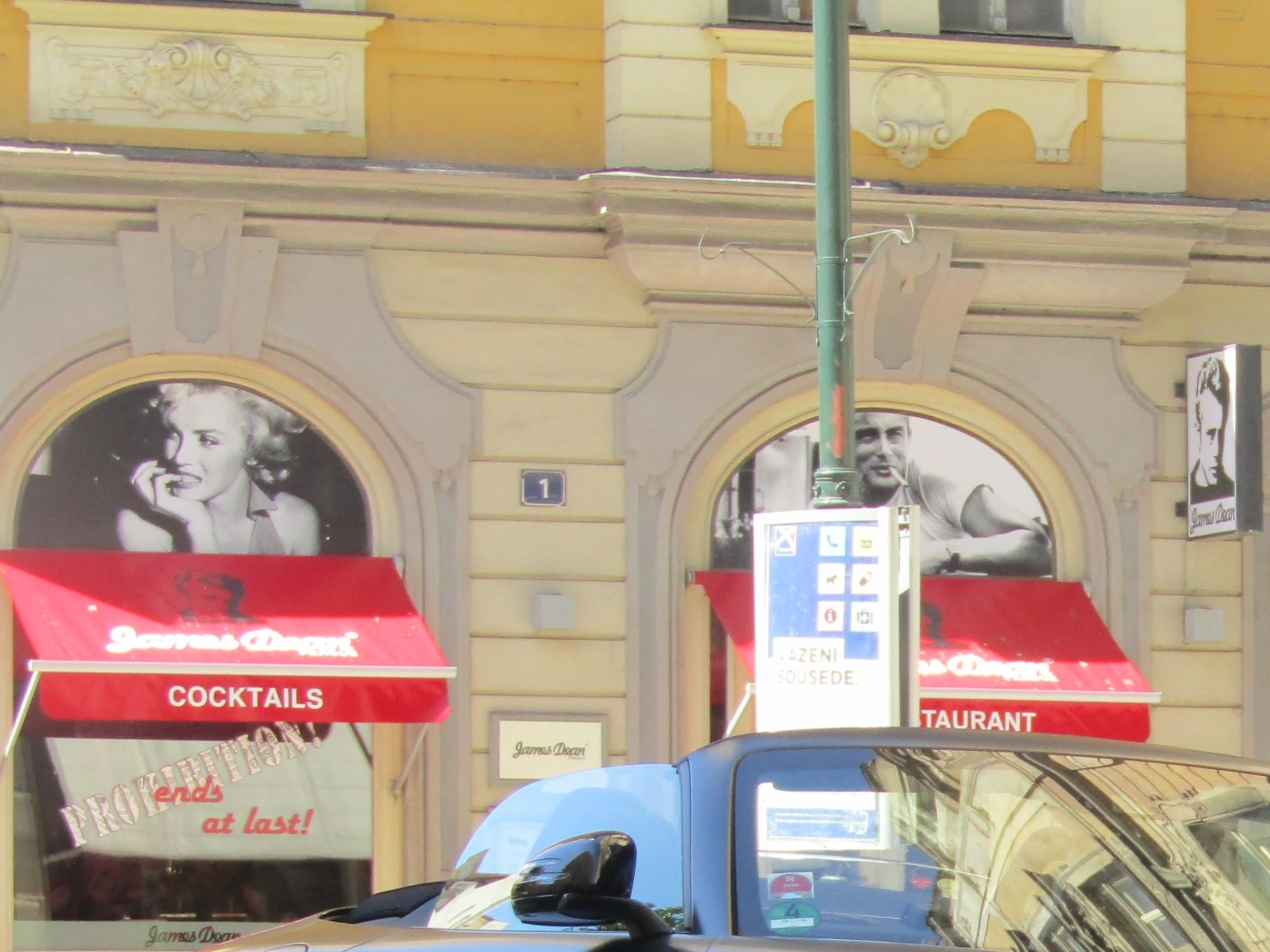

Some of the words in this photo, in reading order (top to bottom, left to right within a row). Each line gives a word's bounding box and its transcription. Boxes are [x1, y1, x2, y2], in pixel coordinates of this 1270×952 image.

[539, 478, 549, 499] 1
[106, 626, 240, 653] James
[168, 685, 324, 710] COCKTAILS
[919, 710, 1037, 733] TAURANT
[512, 741, 552, 758] James
[553, 742, 586, 756] Dean
[154, 774, 224, 804] ends
[202, 813, 235, 835] at
[243, 806, 315, 835] last!
[784, 903, 800, 919] 4
[145, 926, 197, 947] James
